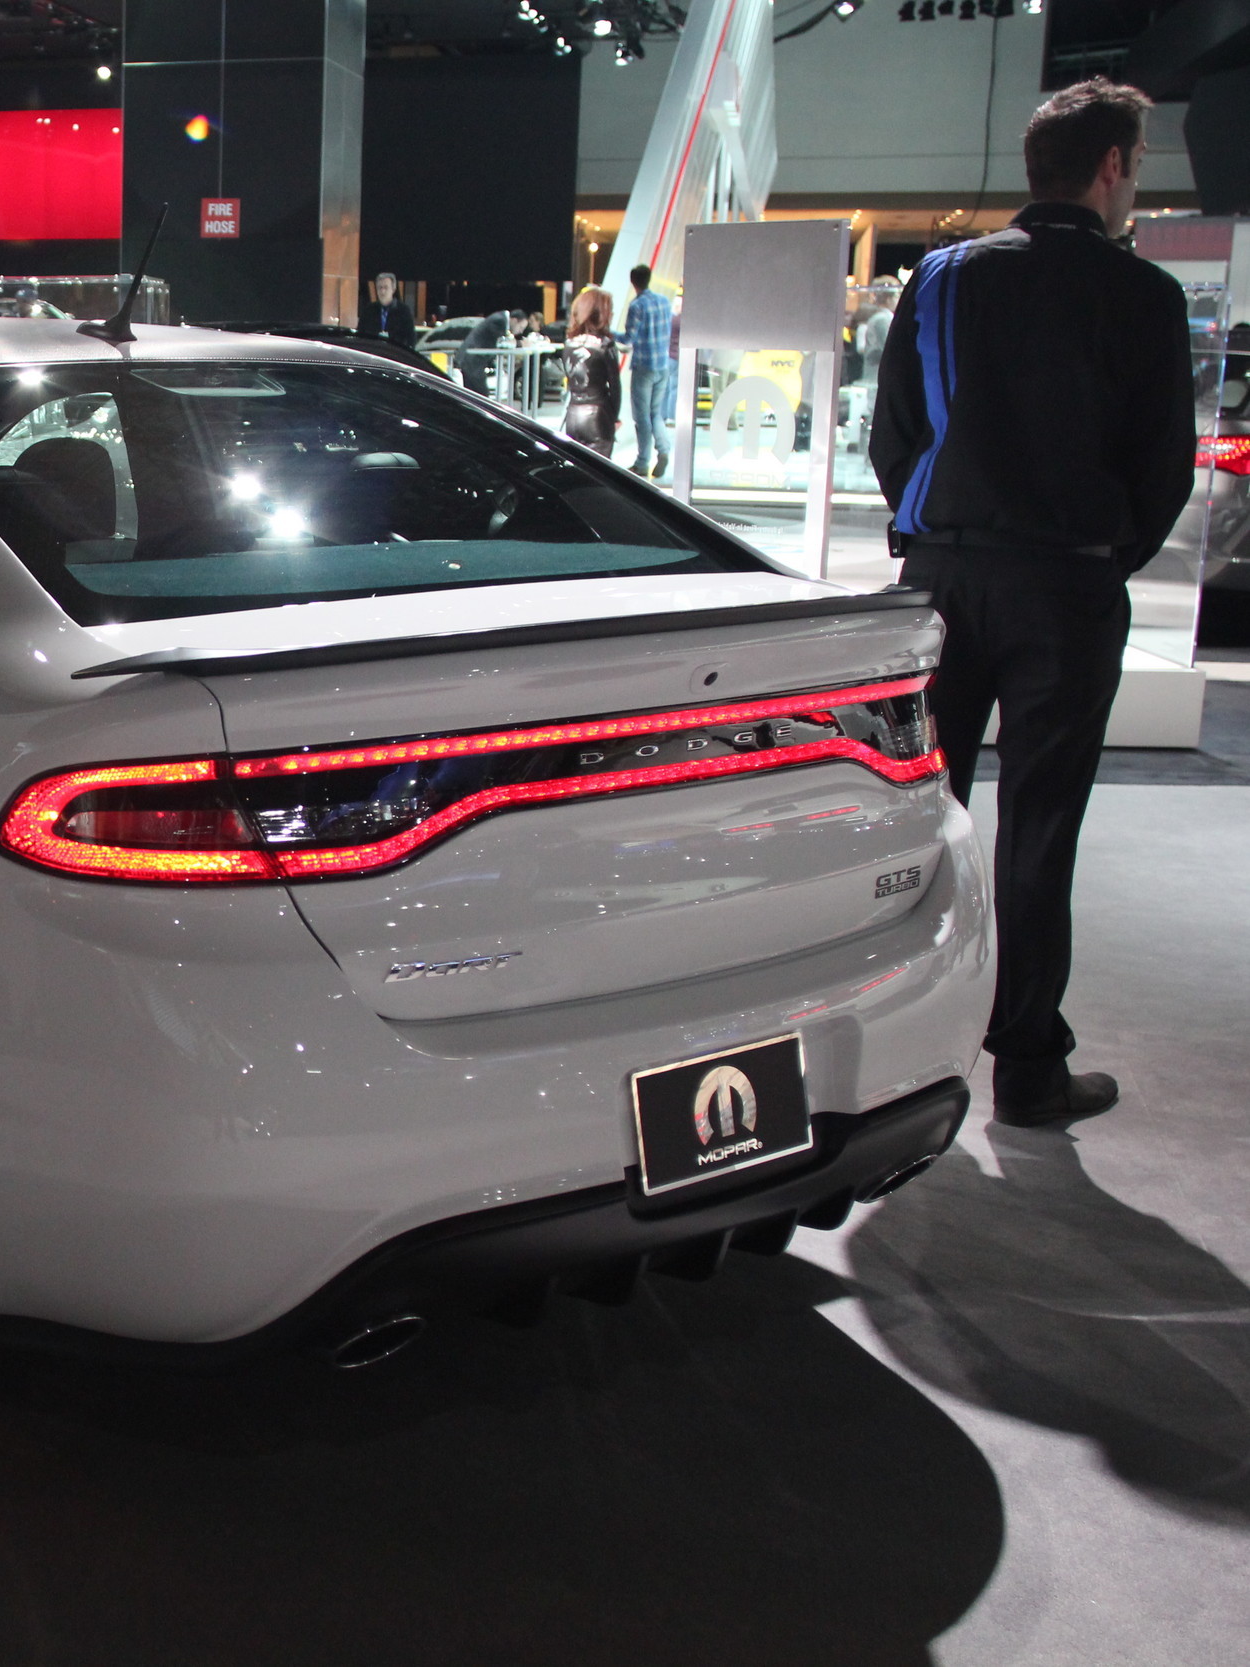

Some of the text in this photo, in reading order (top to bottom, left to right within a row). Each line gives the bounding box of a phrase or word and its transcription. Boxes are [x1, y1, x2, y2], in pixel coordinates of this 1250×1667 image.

[208, 203, 233, 216] FIRE
[205, 220, 236, 234] HOSE
[580, 725, 793, 765] DODGE
[875, 865, 922, 889] GTS
[876, 878, 919, 898] TURBO
